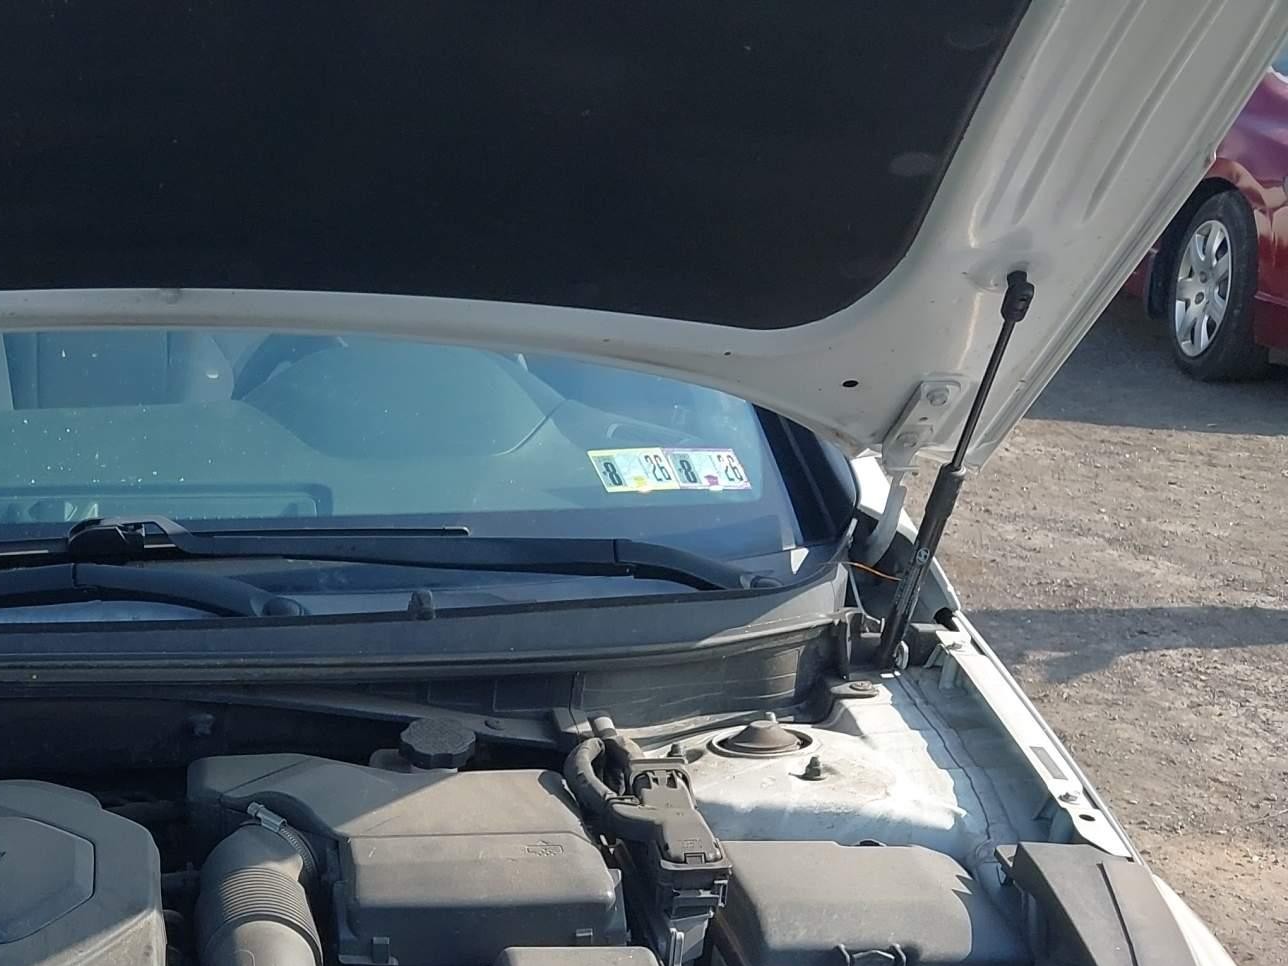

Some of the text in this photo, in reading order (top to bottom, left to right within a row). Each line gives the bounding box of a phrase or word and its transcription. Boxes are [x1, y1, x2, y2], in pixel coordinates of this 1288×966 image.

[602, 454, 672, 487] 8 26
[679, 454, 744, 484] 8 26
